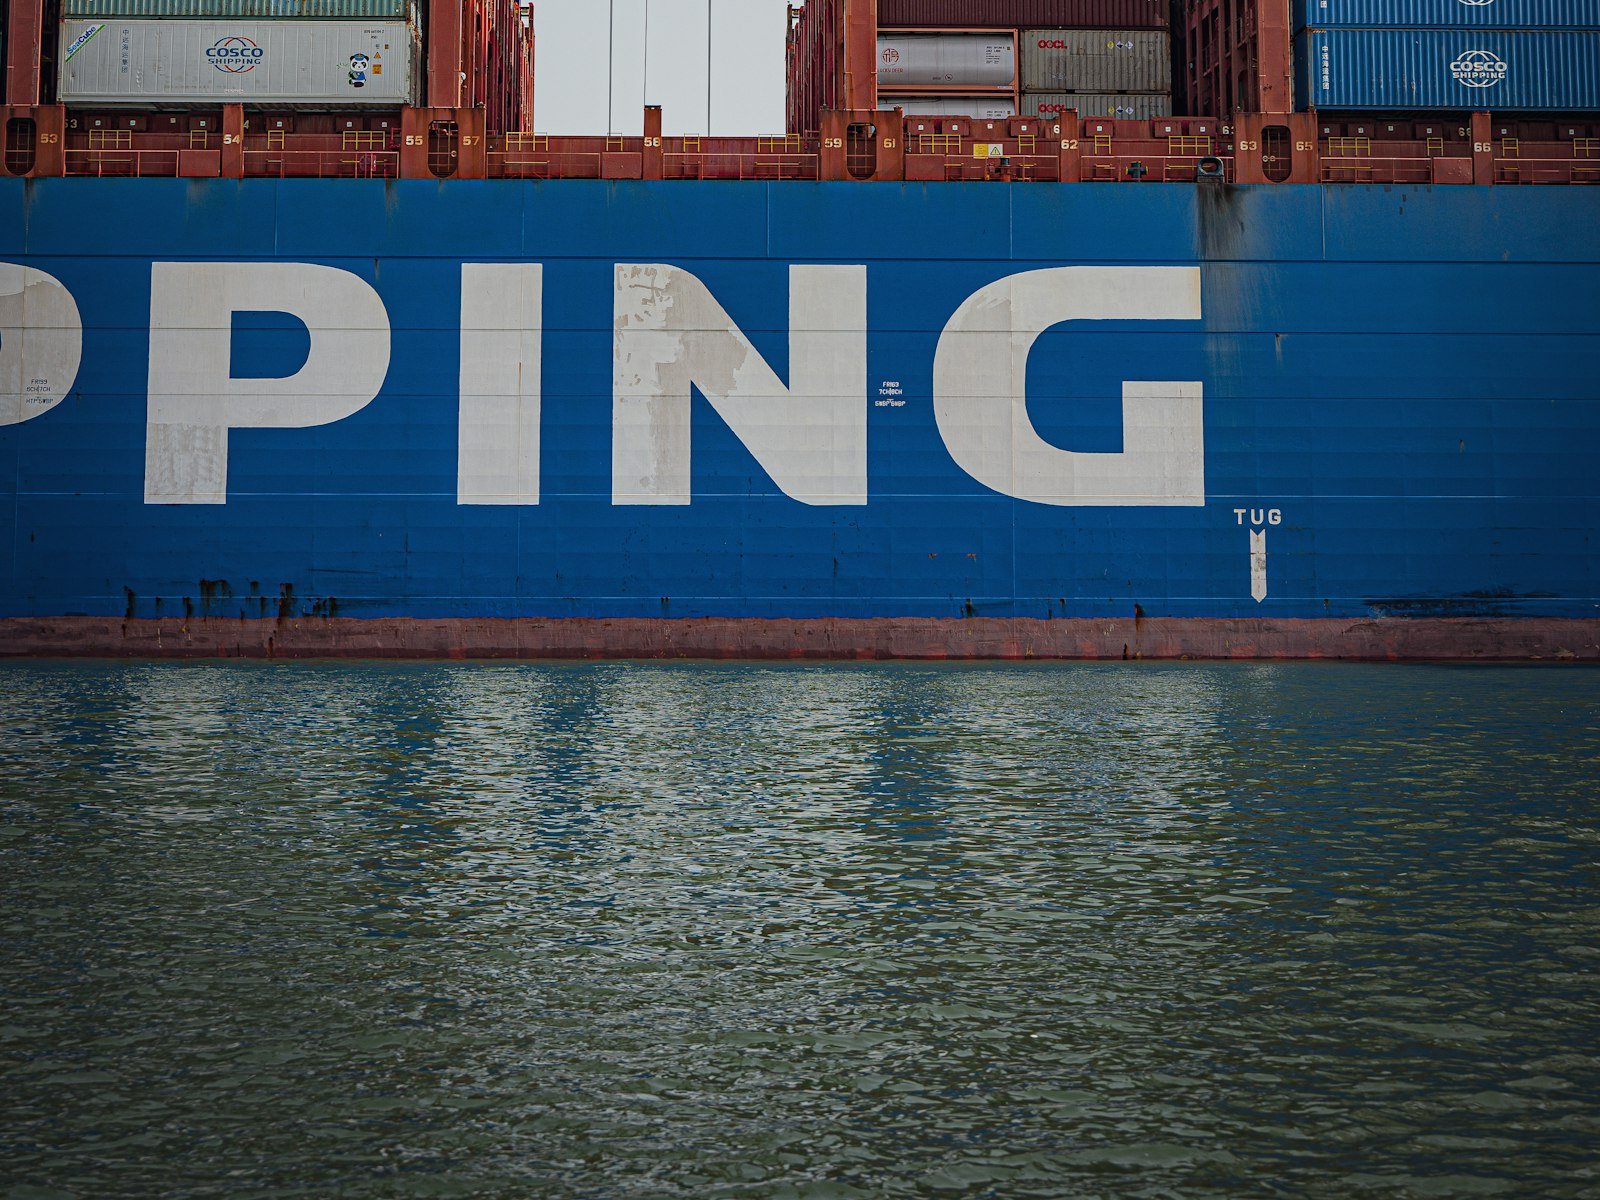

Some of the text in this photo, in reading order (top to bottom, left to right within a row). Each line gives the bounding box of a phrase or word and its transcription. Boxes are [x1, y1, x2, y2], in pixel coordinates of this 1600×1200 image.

[66, 26, 97, 54] SeaCube
[1038, 39, 1068, 50] OOCL
[206, 47, 264, 58] COSCO
[1450, 60, 1508, 71] COSCO
[1452, 71, 1506, 79] SHIPPING
[40, 133, 59, 144] 53
[223, 133, 241, 145] 54
[405, 135, 424, 146] 55
[462, 135, 481, 146] 57
[643, 136, 661, 148] 58
[824, 137, 842, 149] 59
[883, 138, 896, 149] 61
[1060, 139, 1079, 150] 62
[1239, 140, 1258, 151] 63
[1295, 140, 1314, 151] 65
[1473, 142, 1492, 153] 66
[1233, 508, 1282, 526] TUG
